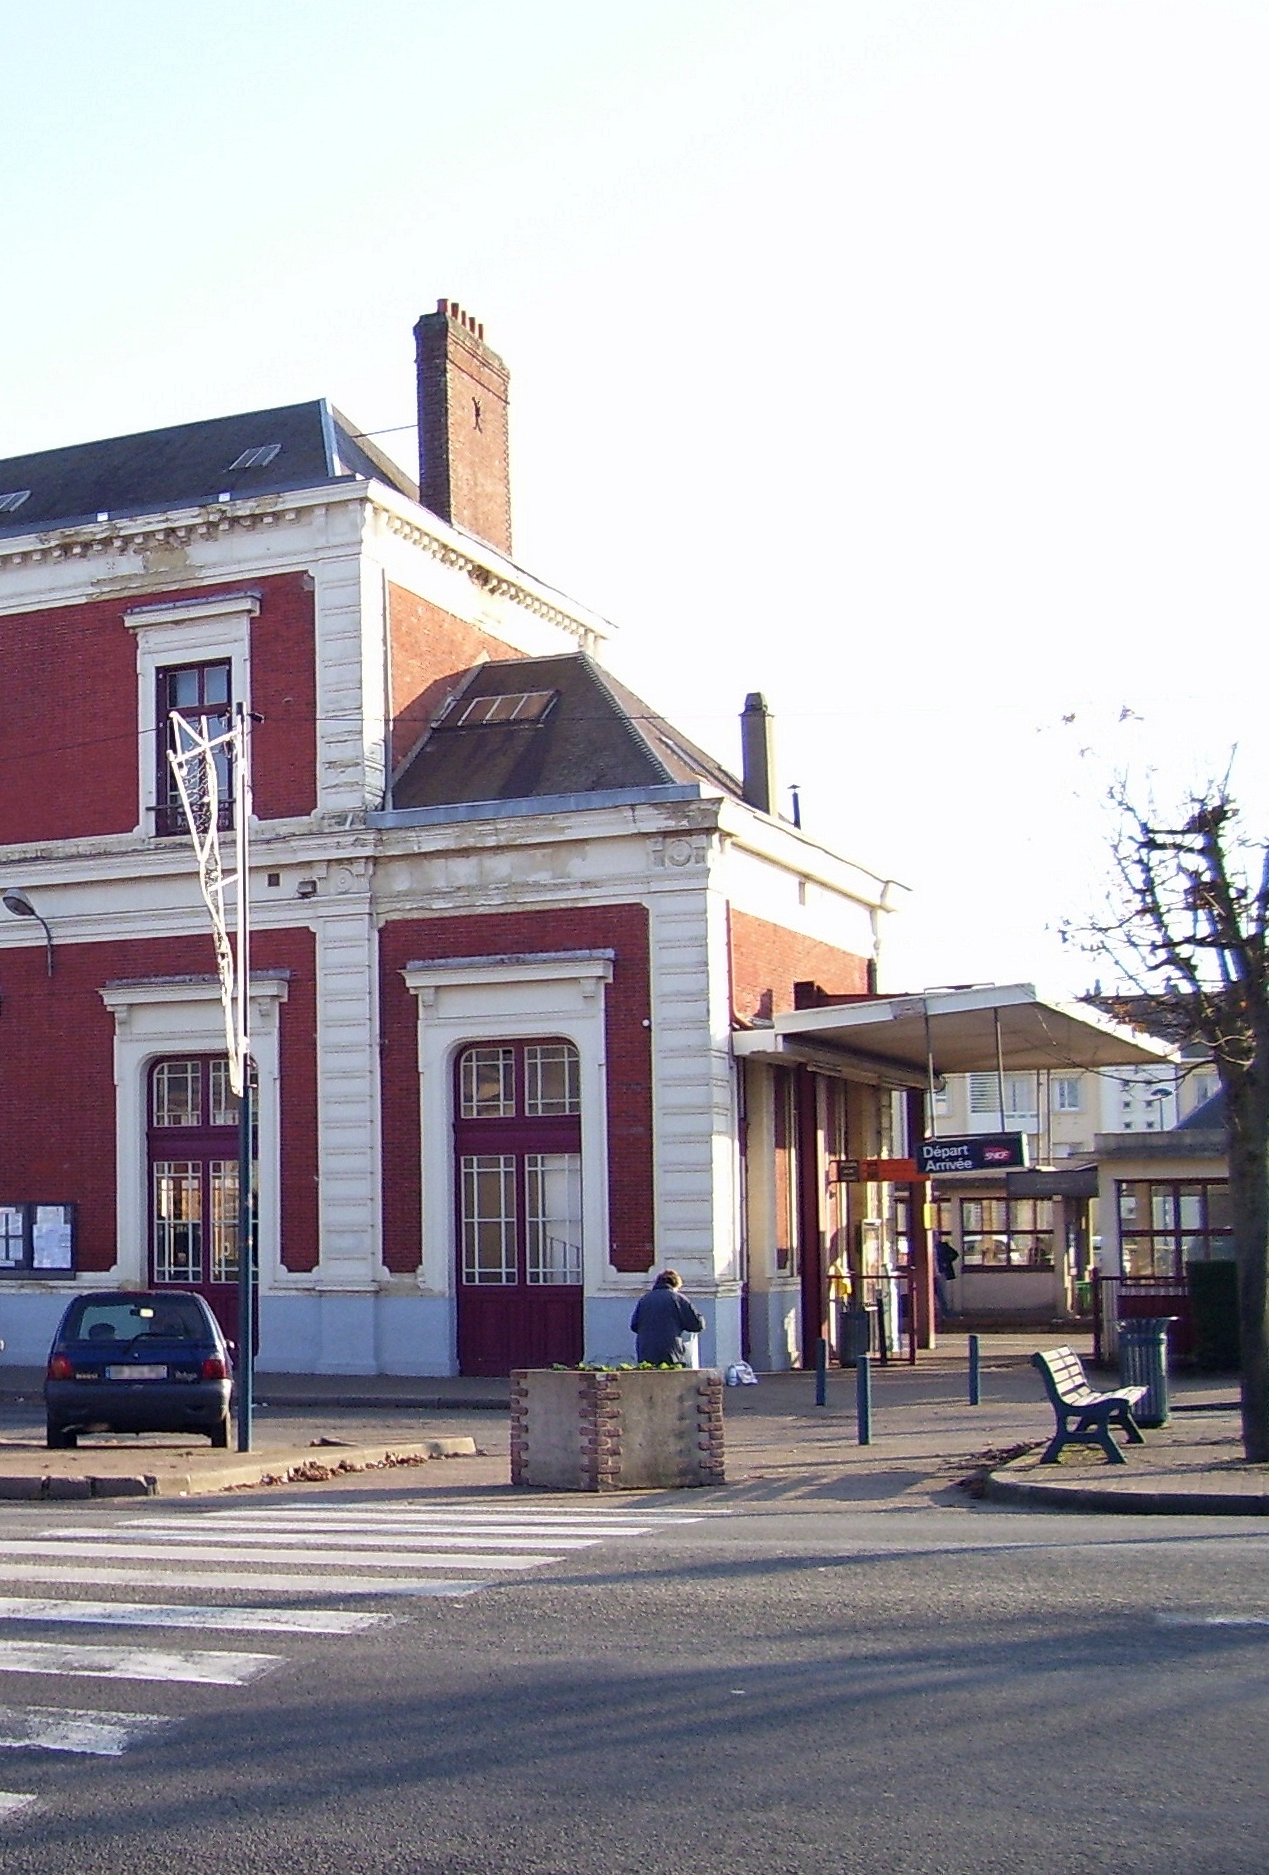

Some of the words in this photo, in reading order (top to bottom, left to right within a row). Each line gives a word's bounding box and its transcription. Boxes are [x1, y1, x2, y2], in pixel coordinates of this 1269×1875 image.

[923, 1145, 969, 1158] Départ
[984, 1151, 1009, 1161] SNCF
[925, 1158, 972, 1172] Arrivée
